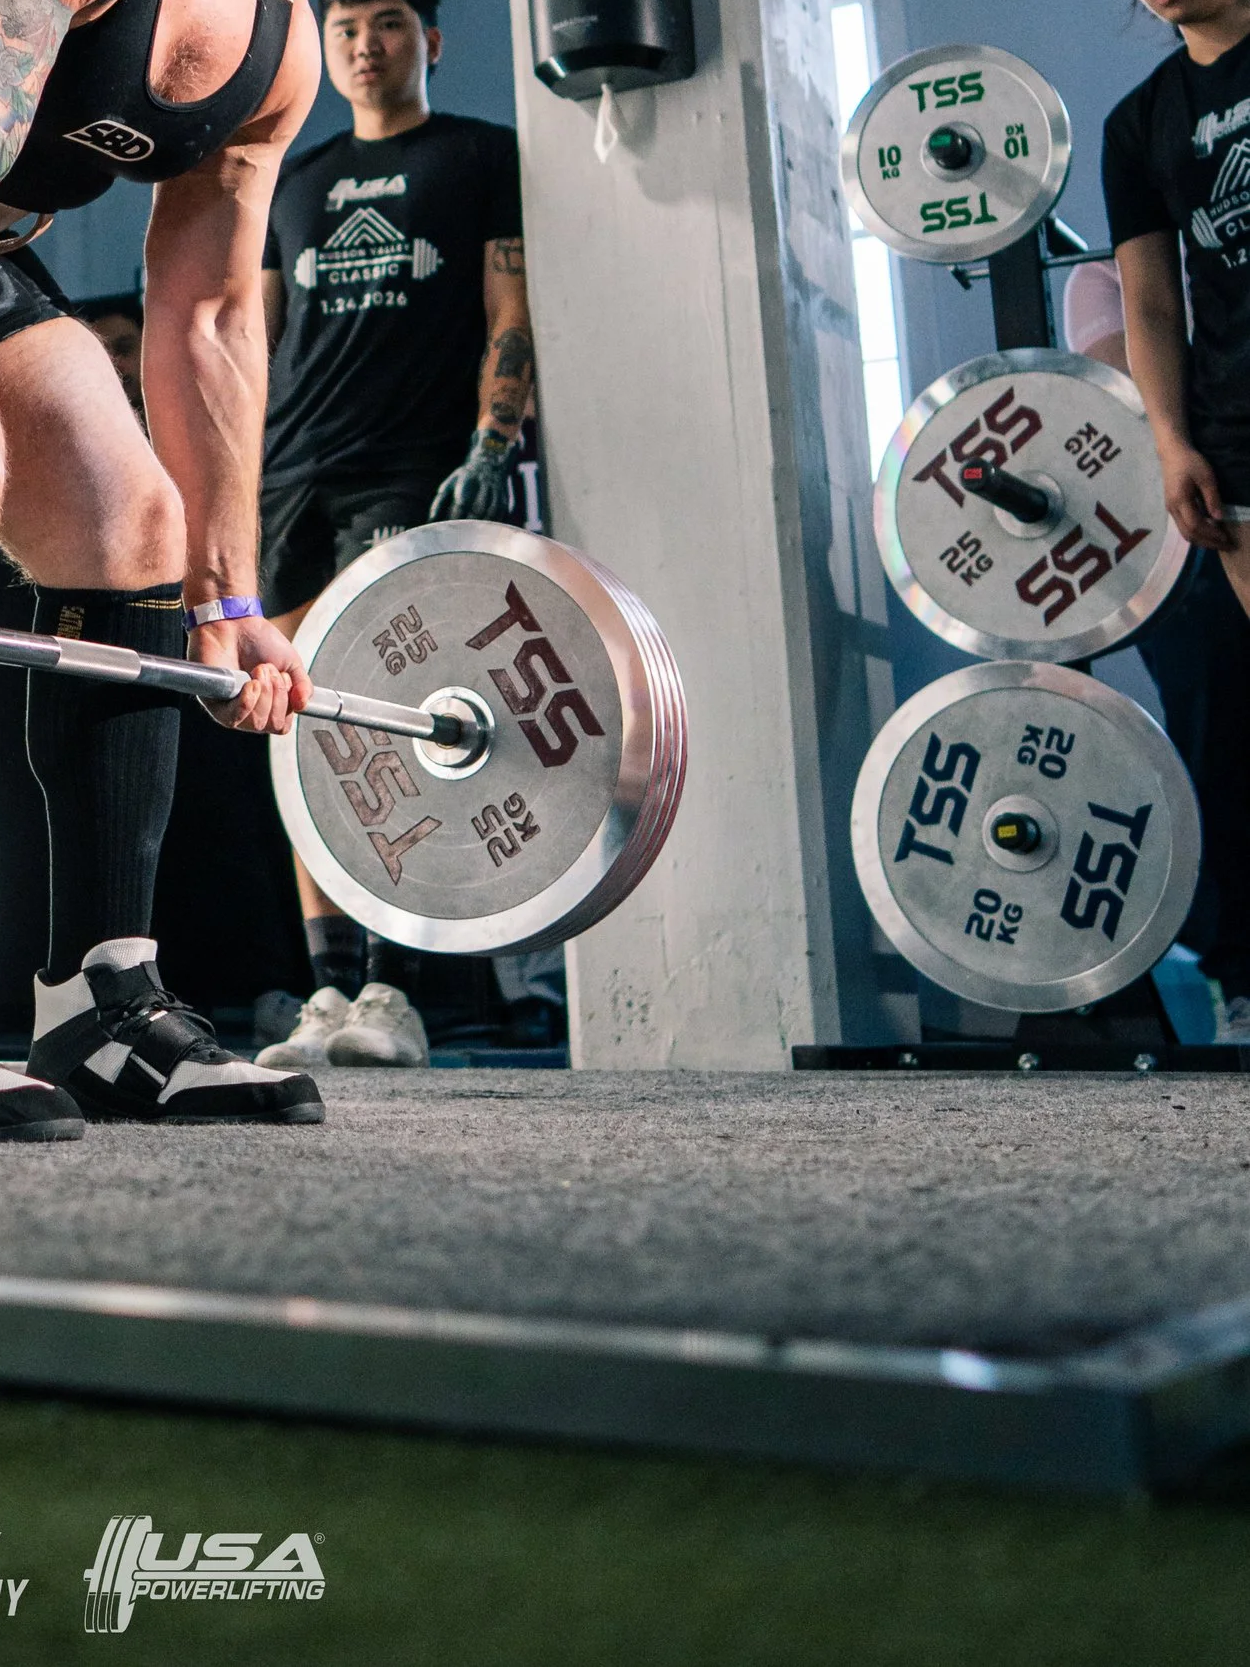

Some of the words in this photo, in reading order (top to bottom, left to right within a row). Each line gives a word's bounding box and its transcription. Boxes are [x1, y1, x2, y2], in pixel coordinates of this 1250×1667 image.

[908, 70, 986, 113] TSS
[68, 121, 152, 160] SBD
[1004, 136, 1029, 160] 10
[1005, 122, 1025, 135] KG
[878, 144, 902, 168] 10
[882, 168, 900, 181] KG
[920, 191, 998, 234] TSS
[328, 262, 399, 284] CLASSIC
[912, 386, 1042, 509] TSS
[1064, 421, 1098, 456] KG
[1075, 434, 1122, 479] 25
[939, 530, 982, 574] 25
[959, 553, 994, 587] KG
[1015, 500, 1152, 627] TSS
[372, 628, 406, 677] KG
[390, 604, 439, 665] 25
[465, 580, 606, 768] TSS
[1017, 723, 1042, 766] KG
[1037, 726, 1075, 780] 20
[504, 791, 542, 844] KG
[894, 731, 981, 866] TSS
[470, 804, 521, 868] 25
[1060, 801, 1153, 942] TSS
[964, 887, 1003, 942] 20
[996, 901, 1023, 945] KG
